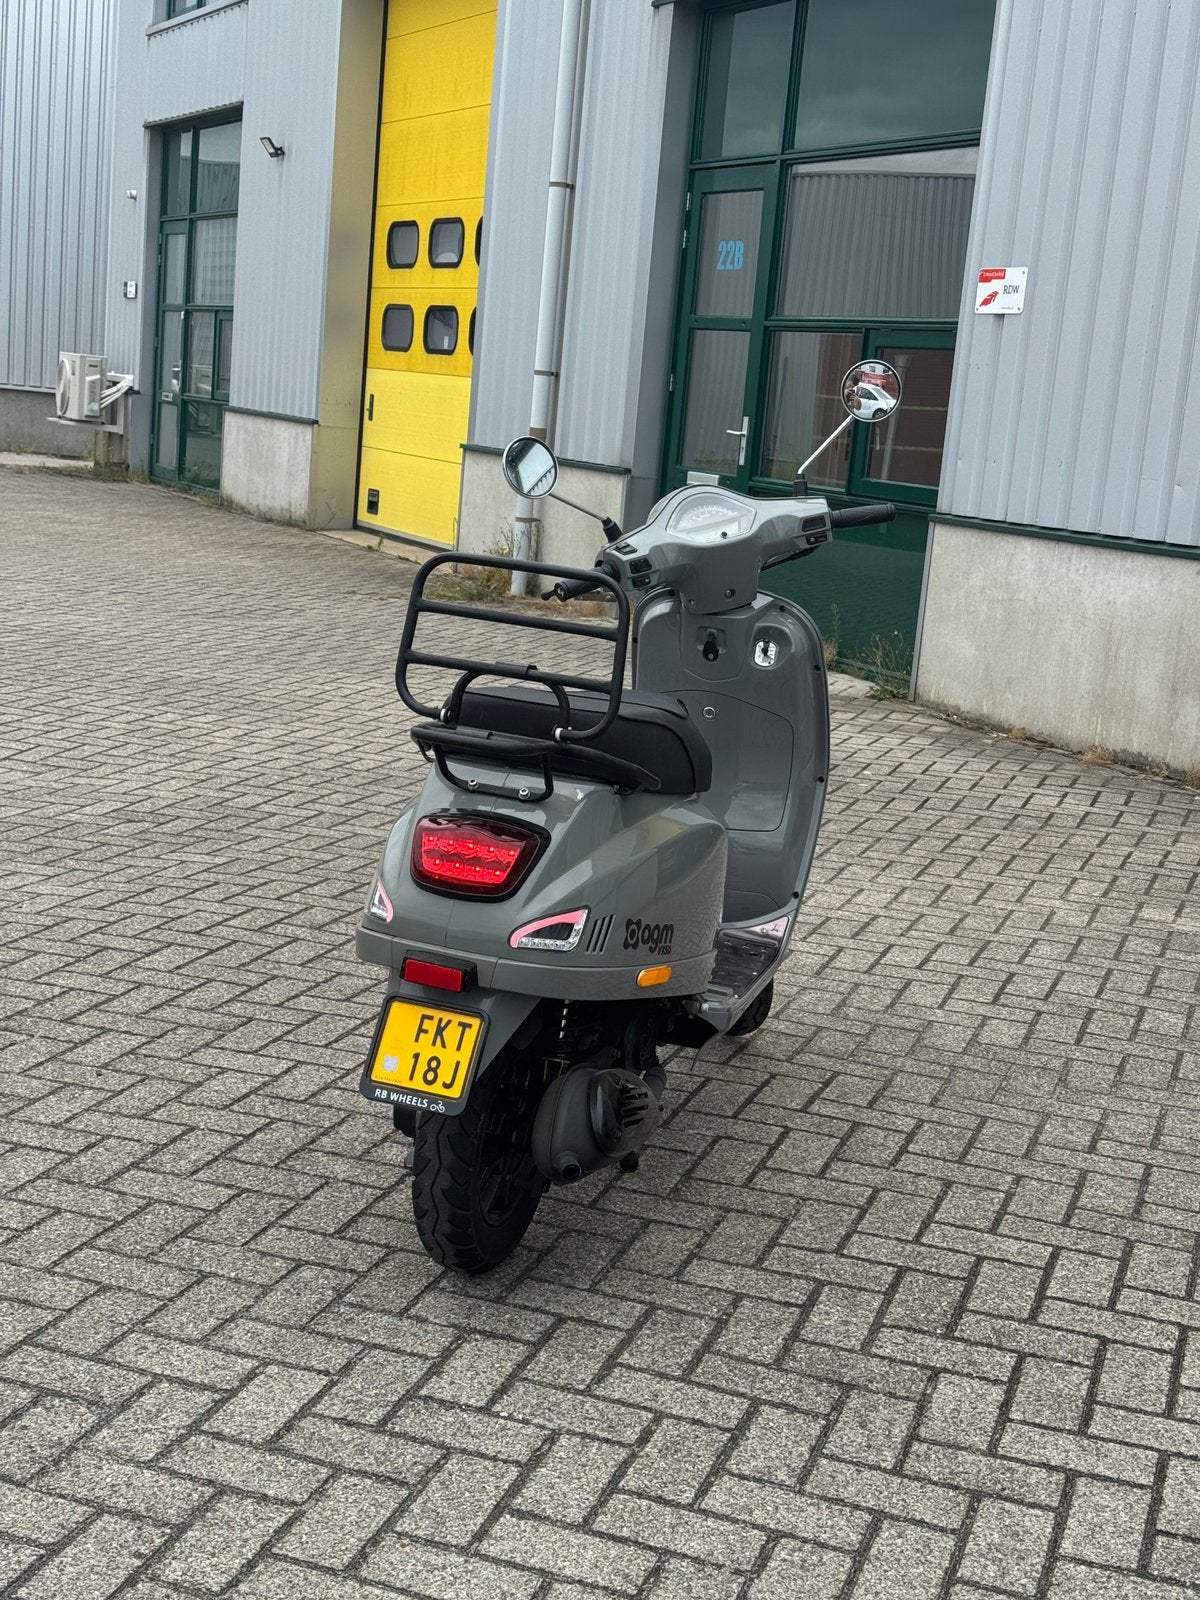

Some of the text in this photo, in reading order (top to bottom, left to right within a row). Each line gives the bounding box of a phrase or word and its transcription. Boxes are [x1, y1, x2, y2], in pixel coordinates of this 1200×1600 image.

[717, 240, 744, 270] 22B
[1003, 285, 1020, 294] RDW
[641, 923, 674, 954] agm
[414, 1013, 473, 1052] FKT
[409, 1052, 461, 1089] 18J
[374, 1088, 428, 1108] RB WHEELS
